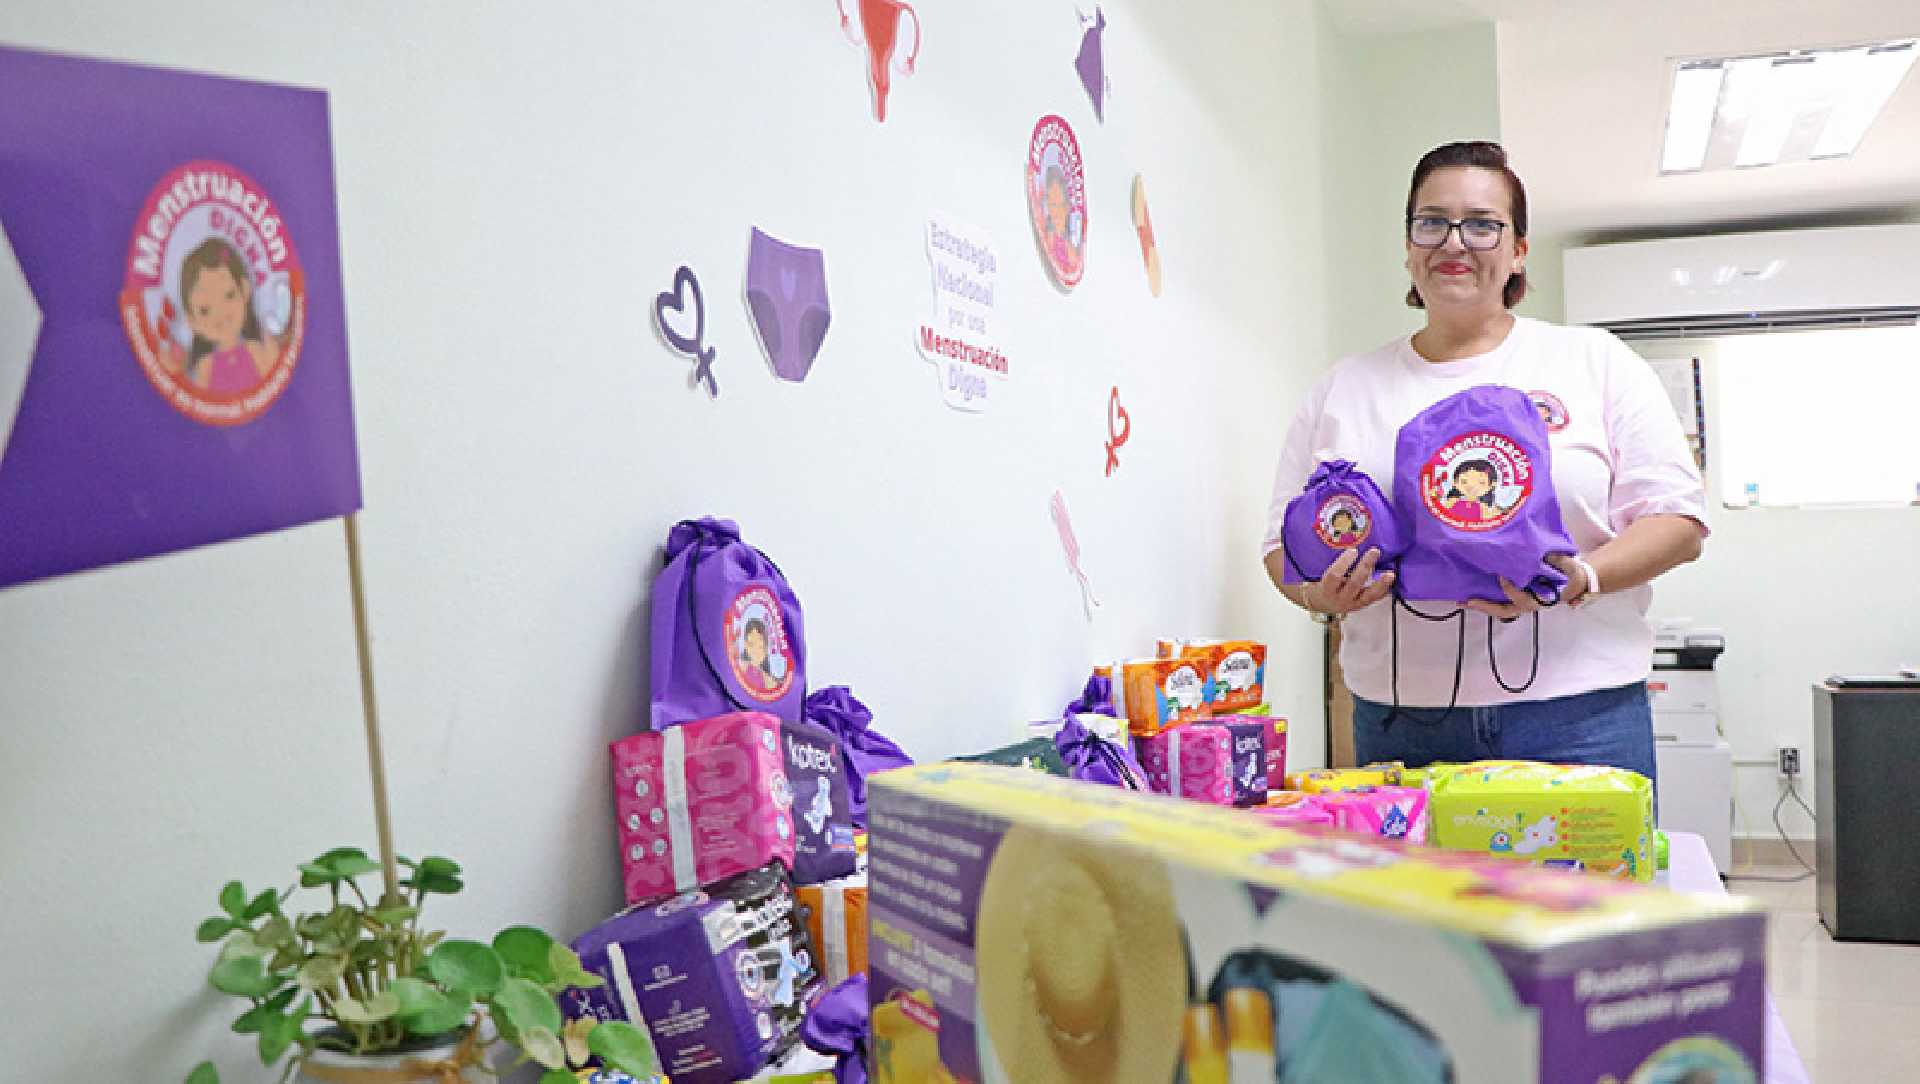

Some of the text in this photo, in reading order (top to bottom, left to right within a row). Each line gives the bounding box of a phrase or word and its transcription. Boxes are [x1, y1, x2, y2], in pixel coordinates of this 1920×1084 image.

[133, 171, 287, 277] Menstruación
[920, 325, 1008, 374] Menstruación
[1440, 433, 1531, 480] Menstruación
[787, 734, 837, 773] kotex
